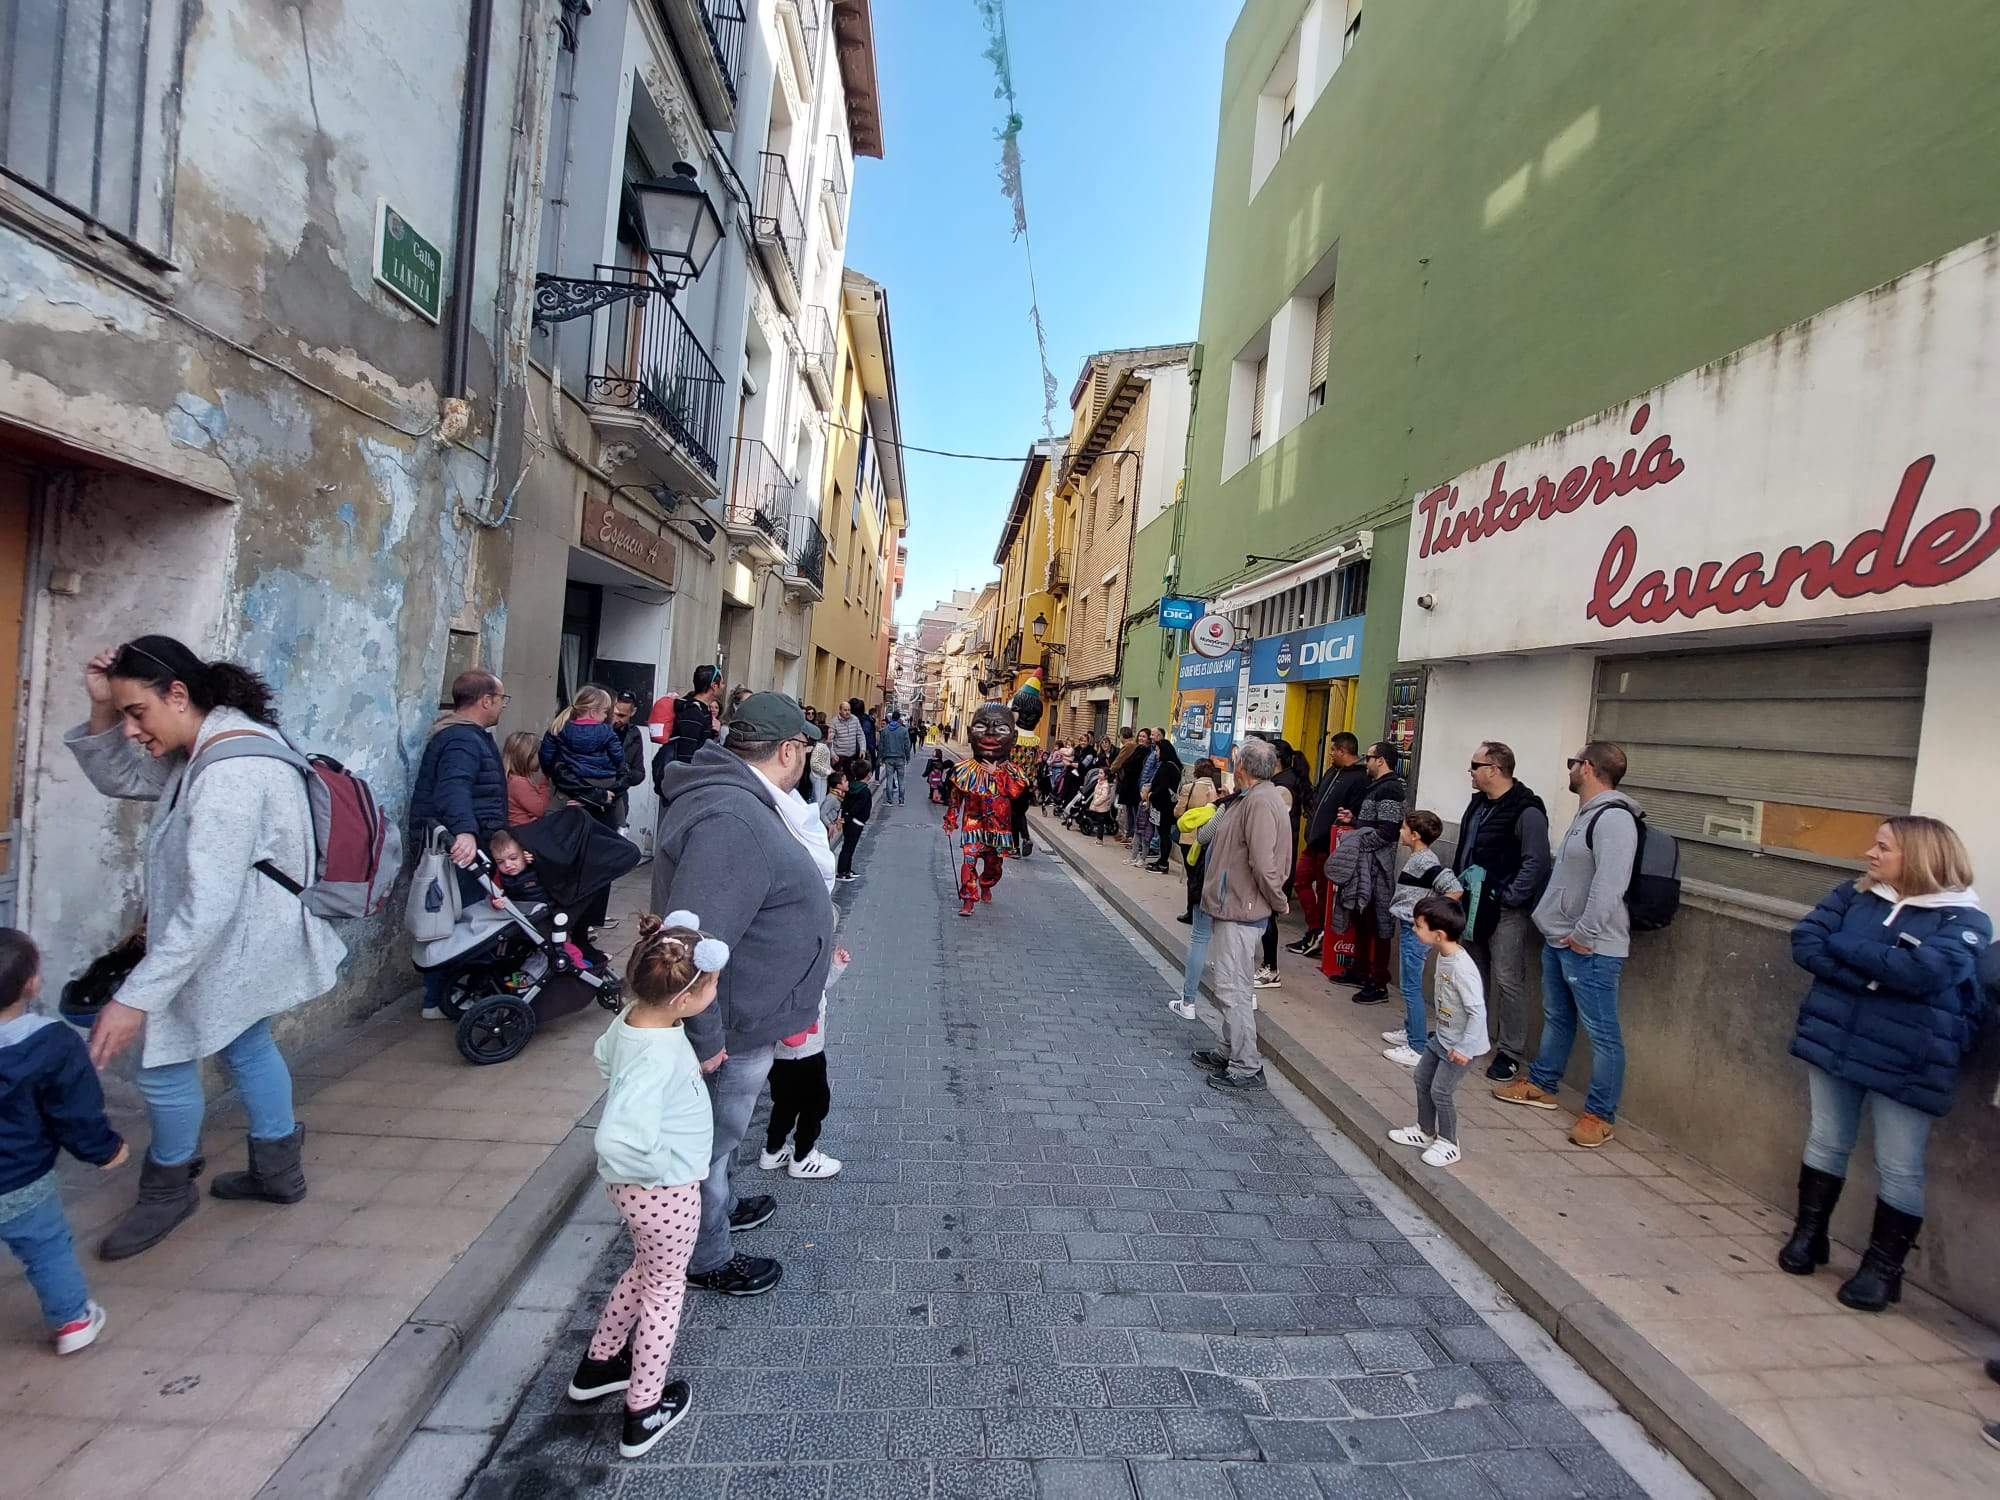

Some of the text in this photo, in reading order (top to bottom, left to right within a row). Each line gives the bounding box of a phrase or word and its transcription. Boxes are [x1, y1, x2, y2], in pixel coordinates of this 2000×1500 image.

[413, 242, 435, 272] Calle
[393, 257, 431, 303] LANUZA
[1163, 610, 1193, 620] DIGI
[1299, 634, 1355, 666] DIGI
[1223, 658, 1236, 672] HAY
[1213, 722, 1232, 734] DIGI
